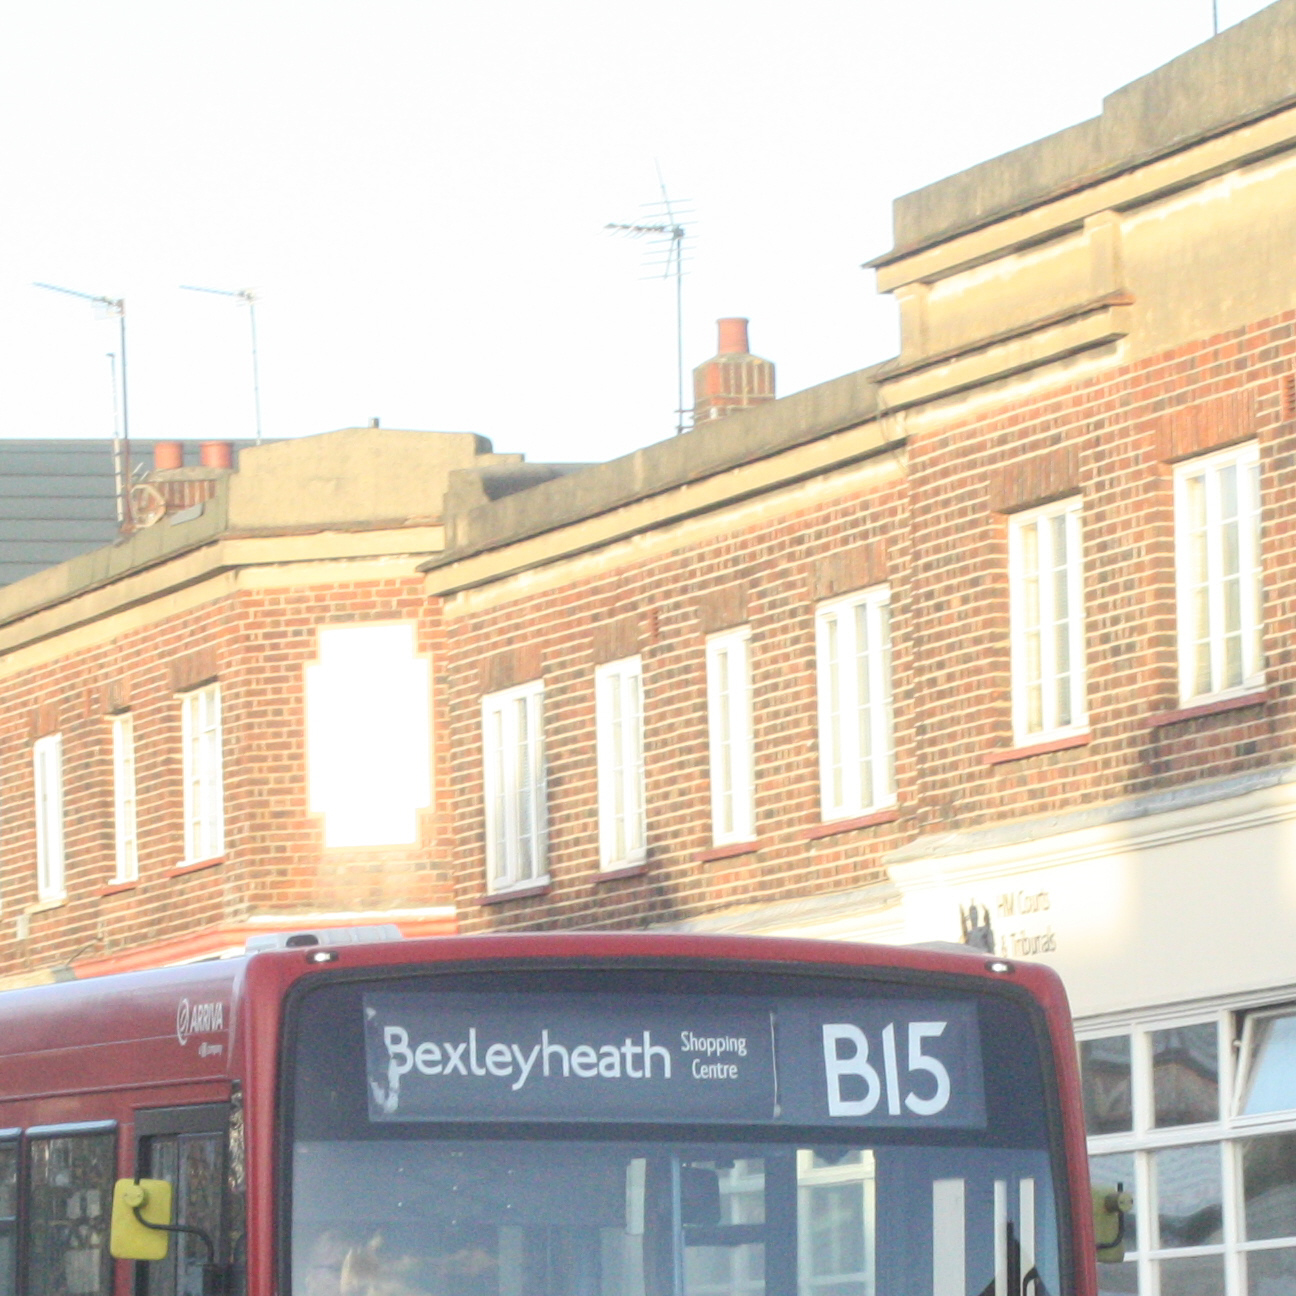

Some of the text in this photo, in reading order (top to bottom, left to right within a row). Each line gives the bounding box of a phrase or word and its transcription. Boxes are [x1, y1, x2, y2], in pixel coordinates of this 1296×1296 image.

[1010, 926, 1057, 957] Tribunals
[189, 1002, 223, 1033] ARRIVA
[384, 1026, 671, 1091] Bexleyheath
[681, 1030, 747, 1056] Shopping
[692, 1060, 738, 1079] Centre
[822, 1021, 951, 1117] B15
